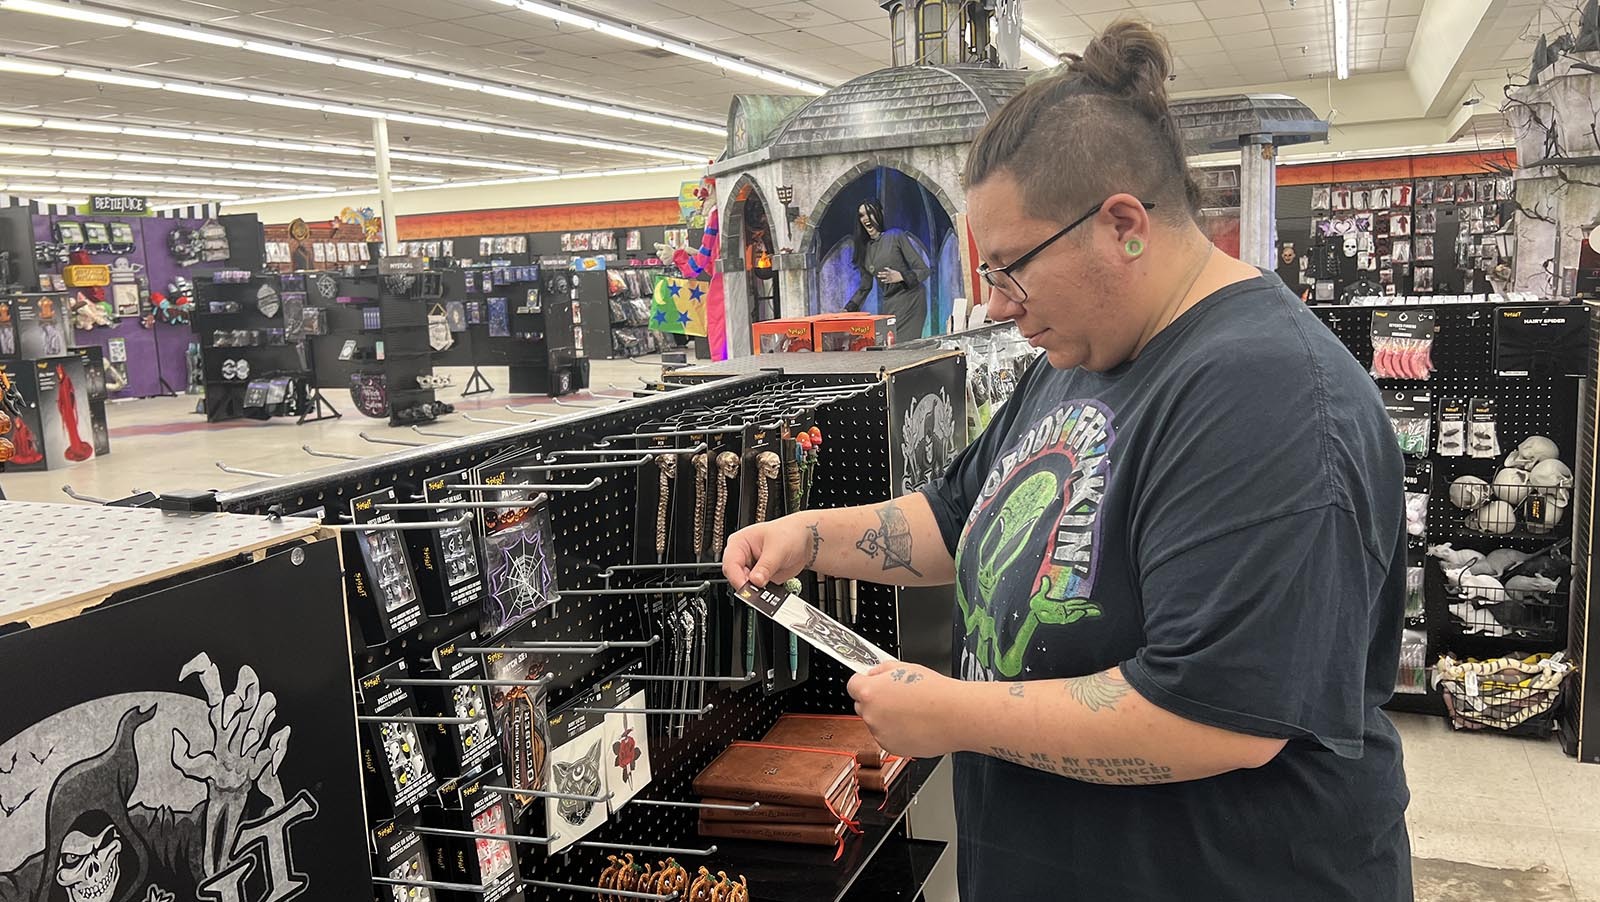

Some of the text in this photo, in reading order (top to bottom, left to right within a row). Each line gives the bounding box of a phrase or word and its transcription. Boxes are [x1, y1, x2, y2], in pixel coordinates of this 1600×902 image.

[95, 197, 143, 212] BEETLEJUICE
[524, 711, 535, 782] OCTOBER
[514, 750, 520, 761] ME
[1062, 756, 1080, 767] MY
[1062, 766, 1102, 777] EVER
[1105, 766, 1171, 777] DANCED
